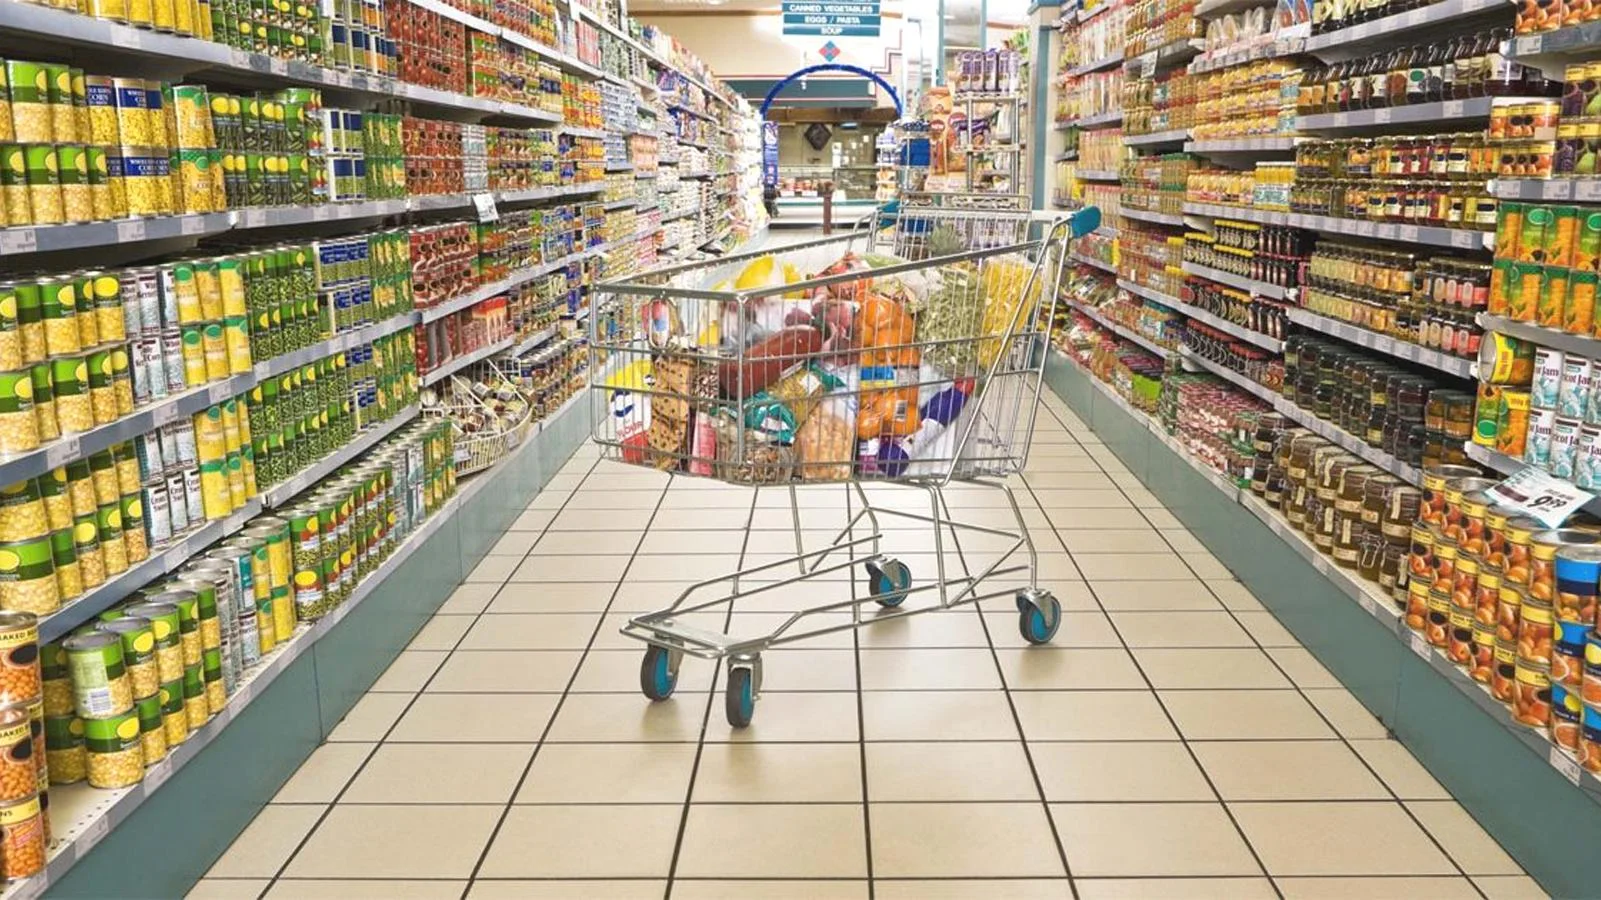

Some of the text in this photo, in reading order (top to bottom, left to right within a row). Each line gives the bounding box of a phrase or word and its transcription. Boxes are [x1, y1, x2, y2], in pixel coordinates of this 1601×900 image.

[789, 4, 873, 14] CANNED VEGETABLES
[836, 16, 861, 24] PASTA
[820, 27, 843, 35] SOUP
